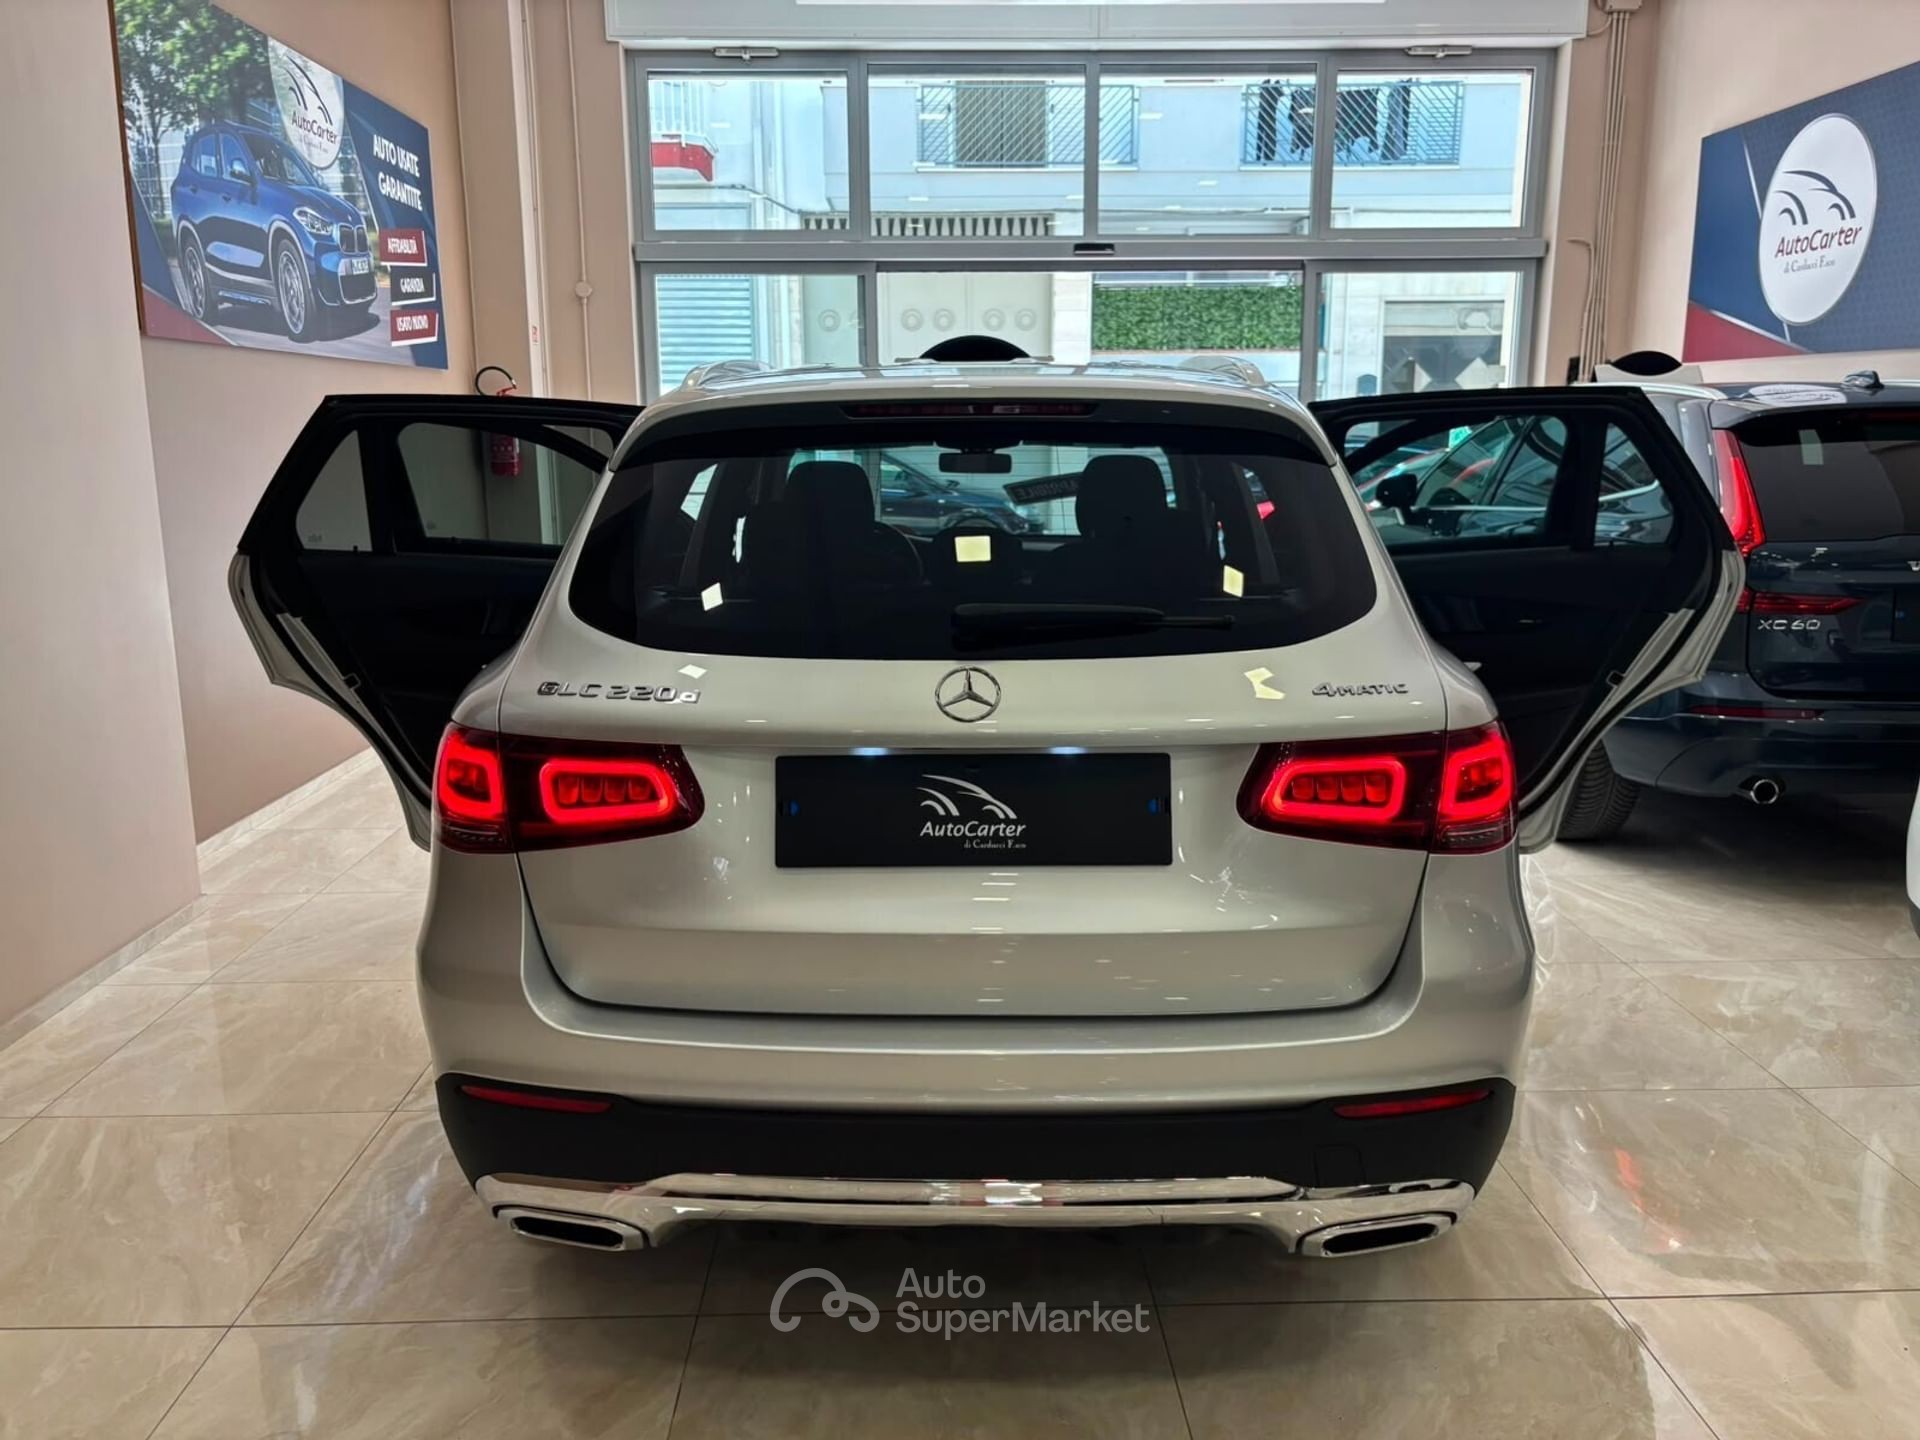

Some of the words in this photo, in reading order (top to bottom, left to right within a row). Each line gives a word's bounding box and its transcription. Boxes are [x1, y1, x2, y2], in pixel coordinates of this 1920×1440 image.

[292, 110, 338, 144] AutoCarter
[373, 134, 397, 166] AUTO
[397, 145, 421, 178] USATE
[378, 171, 423, 211] GARANTITE
[1774, 226, 1862, 258] AutoCarter
[537, 681, 602, 698] GLC
[605, 684, 701, 703] 220d
[1311, 682, 1409, 698] 4MATIC
[920, 821, 1027, 837] AutoCarter
